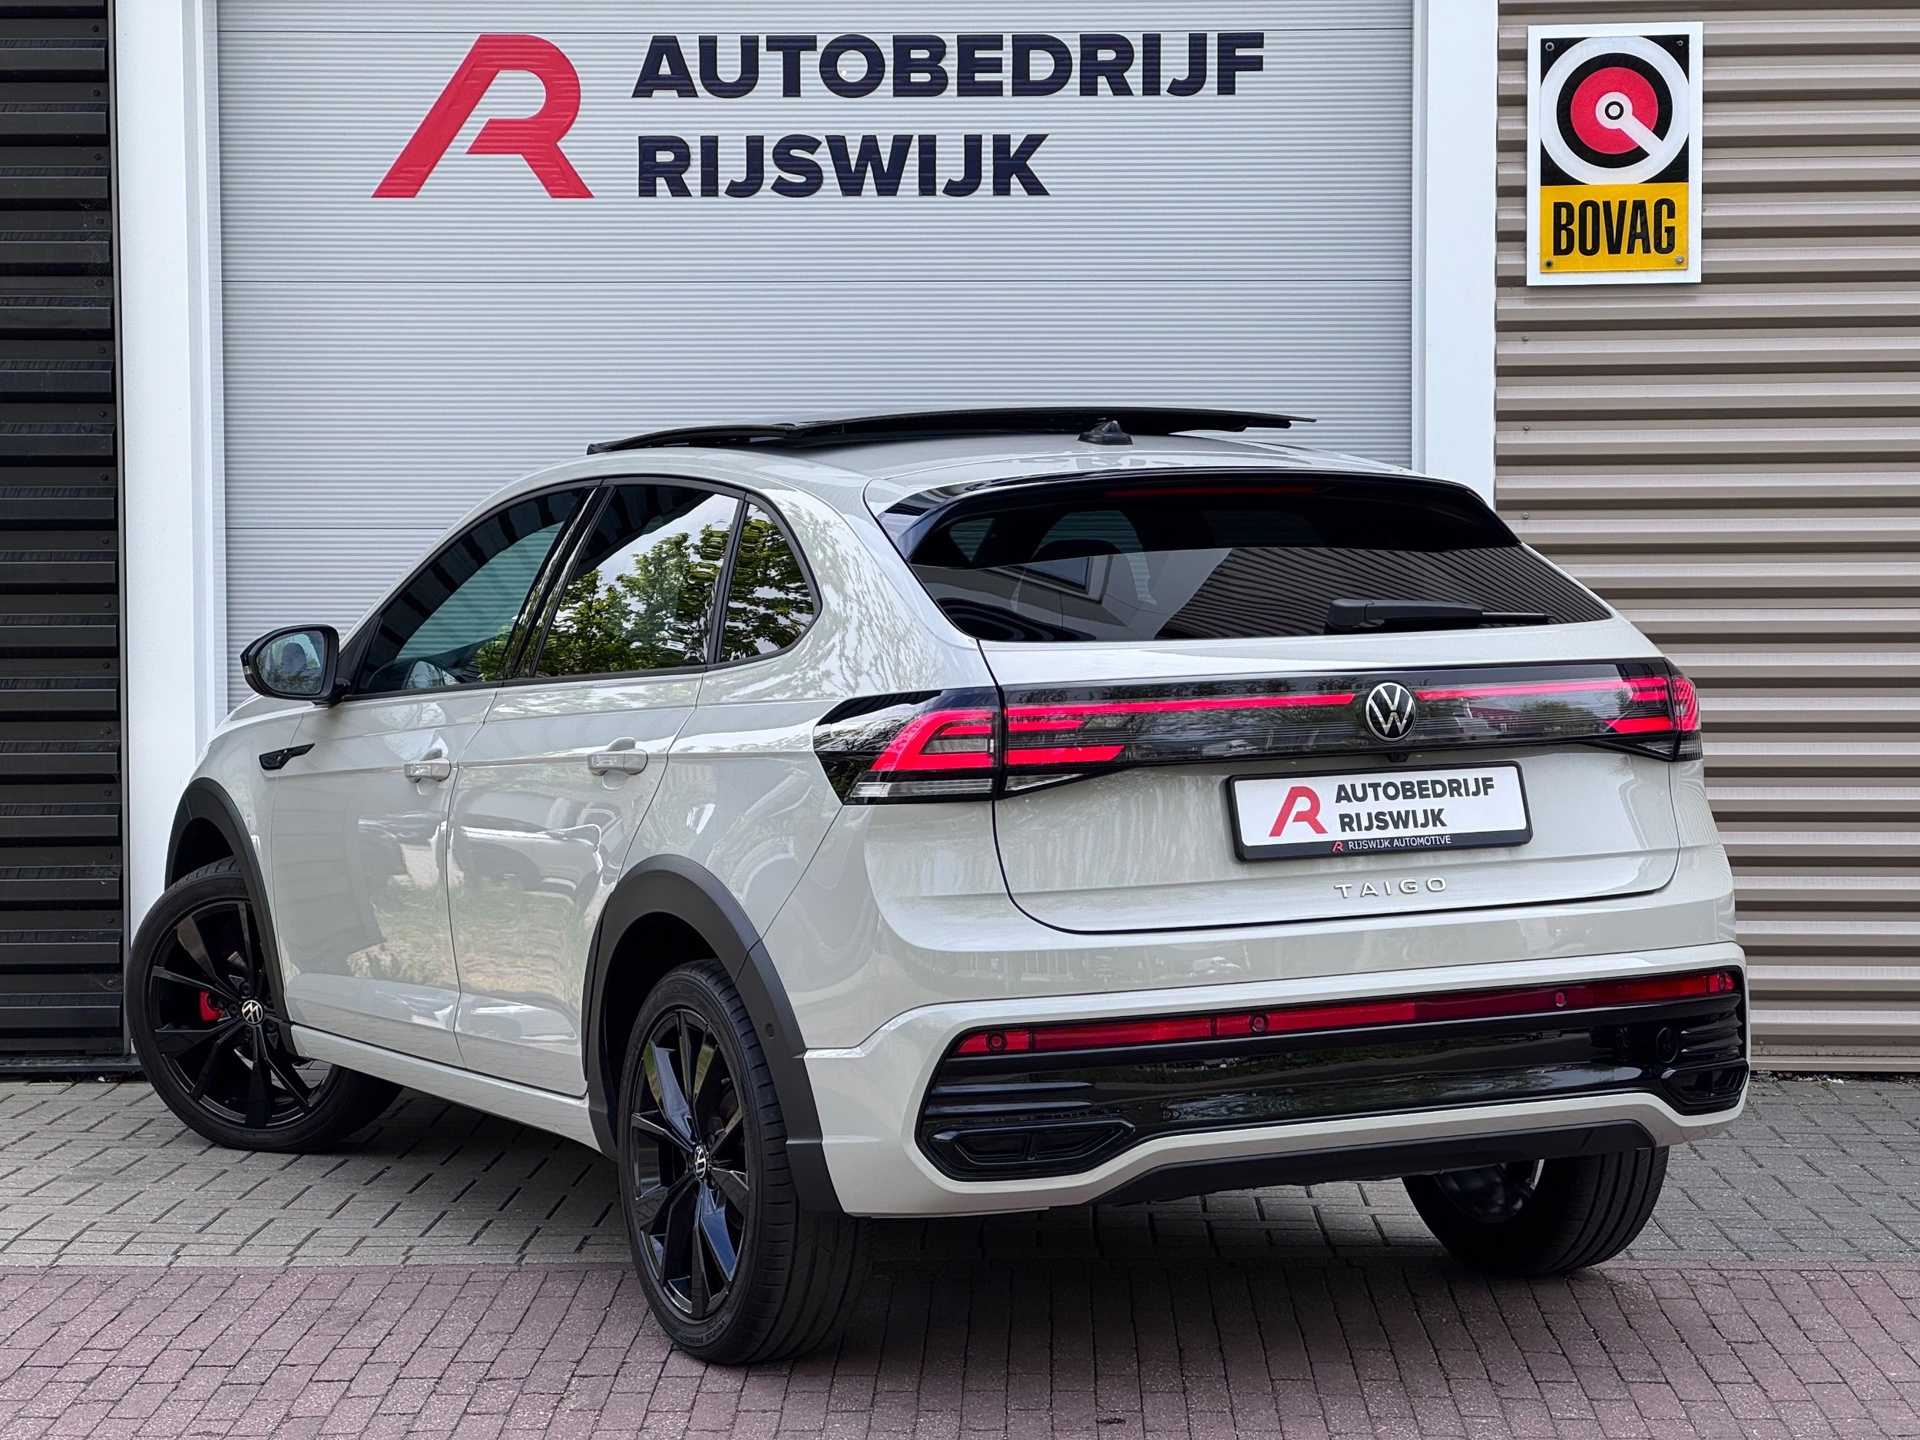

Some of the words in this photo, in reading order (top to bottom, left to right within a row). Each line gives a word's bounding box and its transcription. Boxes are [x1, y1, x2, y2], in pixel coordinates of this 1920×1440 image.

[631, 32, 1265, 98] AUTOBEDRIJF
[637, 133, 1050, 198] RIJSWIJK
[1553, 197, 1676, 257] BOVAG
[1335, 776, 1495, 804] AUTOBEDRIJF
[1338, 808, 1448, 833] RIJSWIJK
[1348, 839, 1391, 850] RIJSWIJK
[1393, 835, 1452, 847] AUTOMOTIVE
[1334, 877, 1447, 898] TAIGO
